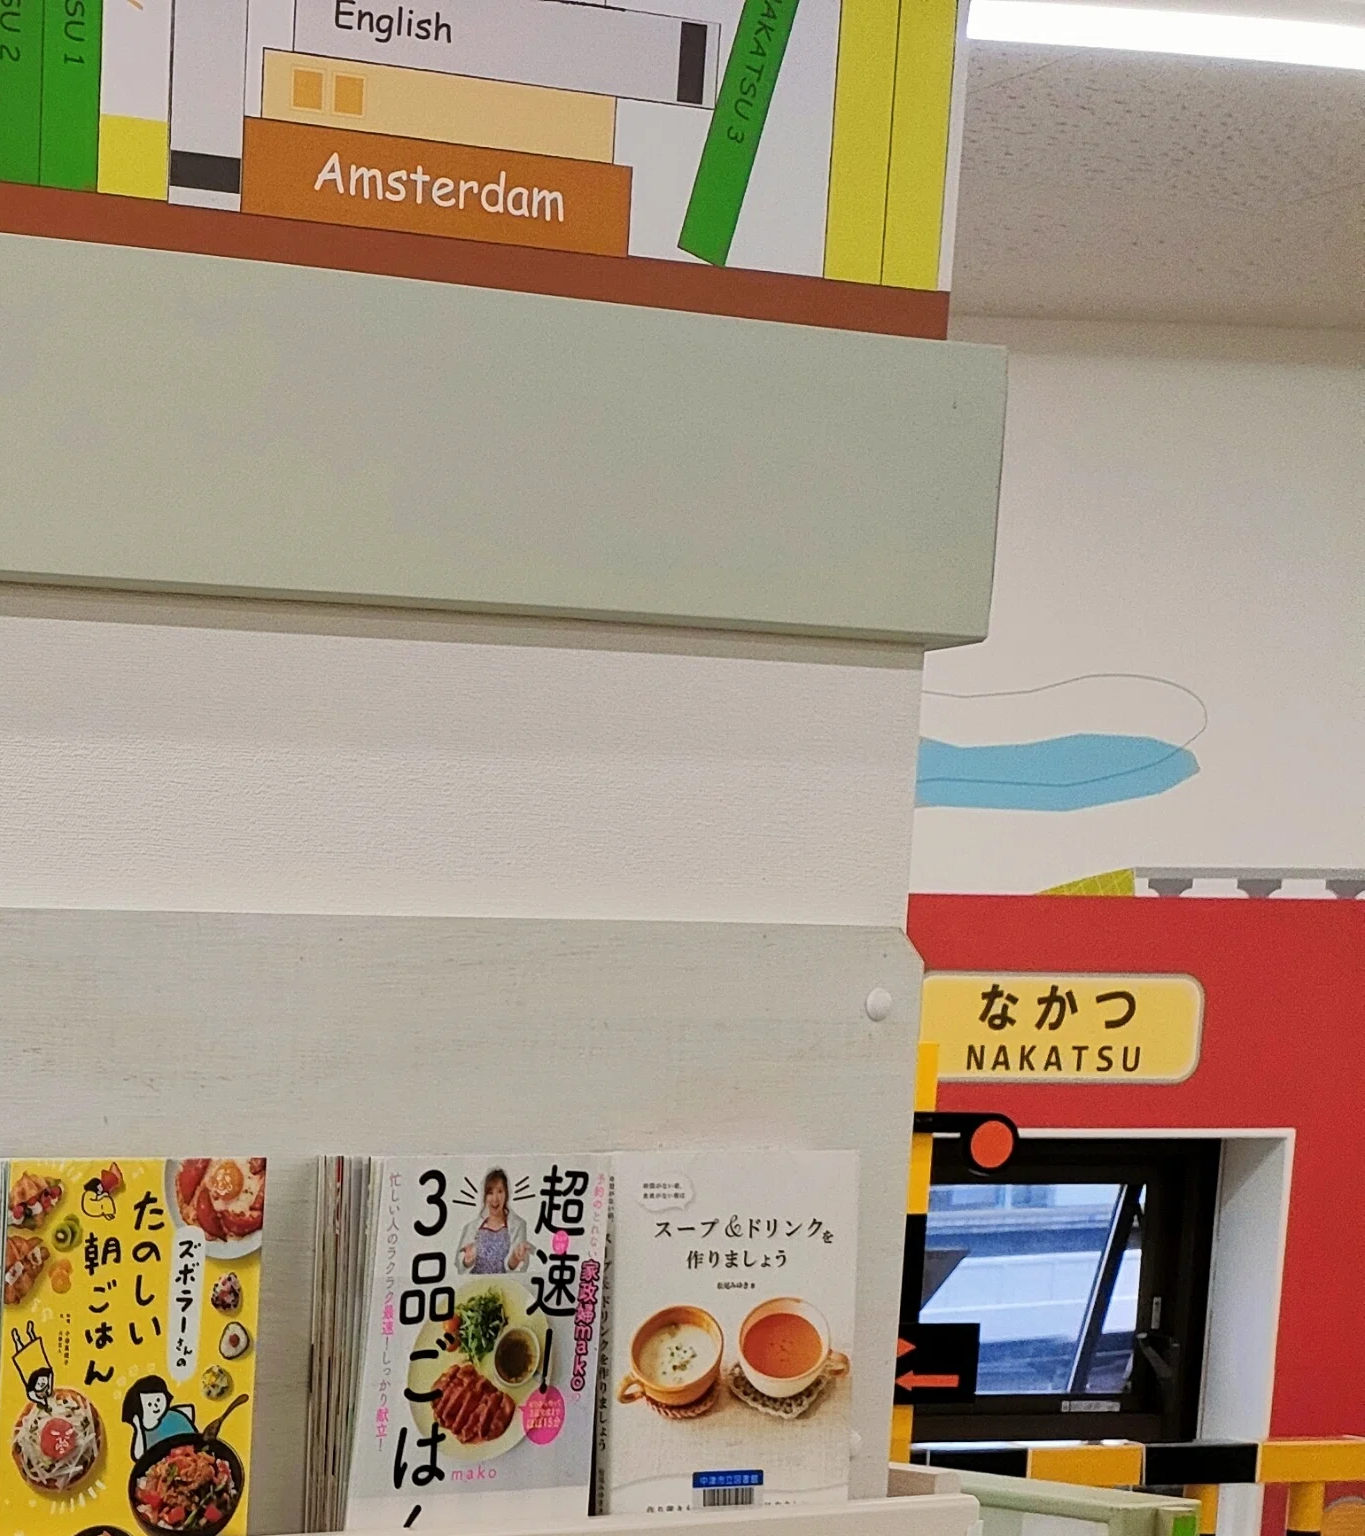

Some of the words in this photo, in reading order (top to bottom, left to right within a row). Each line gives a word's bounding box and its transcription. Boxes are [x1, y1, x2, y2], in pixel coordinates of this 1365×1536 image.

[333, 0, 454, 45] English
[0, 44, 21, 62] 2
[63, 53, 85, 65] 1
[734, 0, 782, 121] AKATSU
[727, 126, 745, 144] 3
[314, 151, 566, 223] Amsterdam
[976, 983, 1137, 1031] なかつ
[965, 1044, 1142, 1073] NAKATSU
[129, 1189, 166, 1346] たのしい
[685, 1249, 788, 1270] 作りましょう
[82, 1231, 122, 1387] 朝ごはん
[173, 1238, 200, 1369] ズボラーさんの
[392, 1168, 456, 1530] 3品ごは
[449, 1464, 498, 1483] mako
